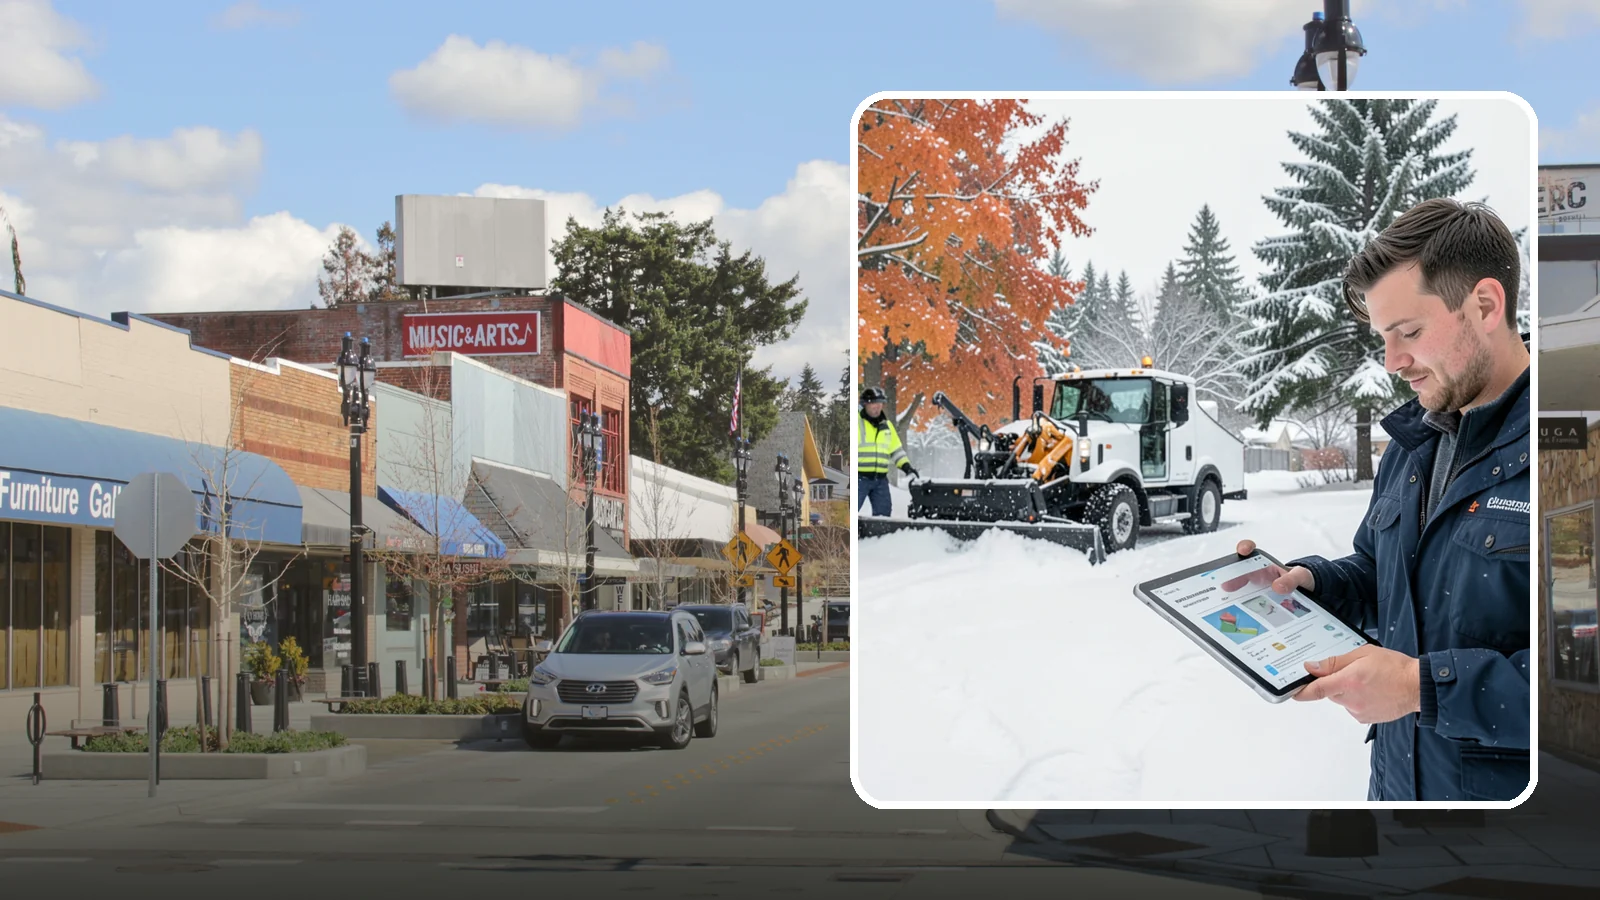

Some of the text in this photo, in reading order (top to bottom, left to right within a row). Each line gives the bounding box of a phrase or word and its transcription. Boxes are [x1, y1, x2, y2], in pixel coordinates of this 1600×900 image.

[408, 323, 520, 349] MUSIC&ARTS
[1540, 427, 1577, 436] UGA
[0, 471, 121, 519] Furniture Gal
[452, 562, 480, 575] SUSHI
